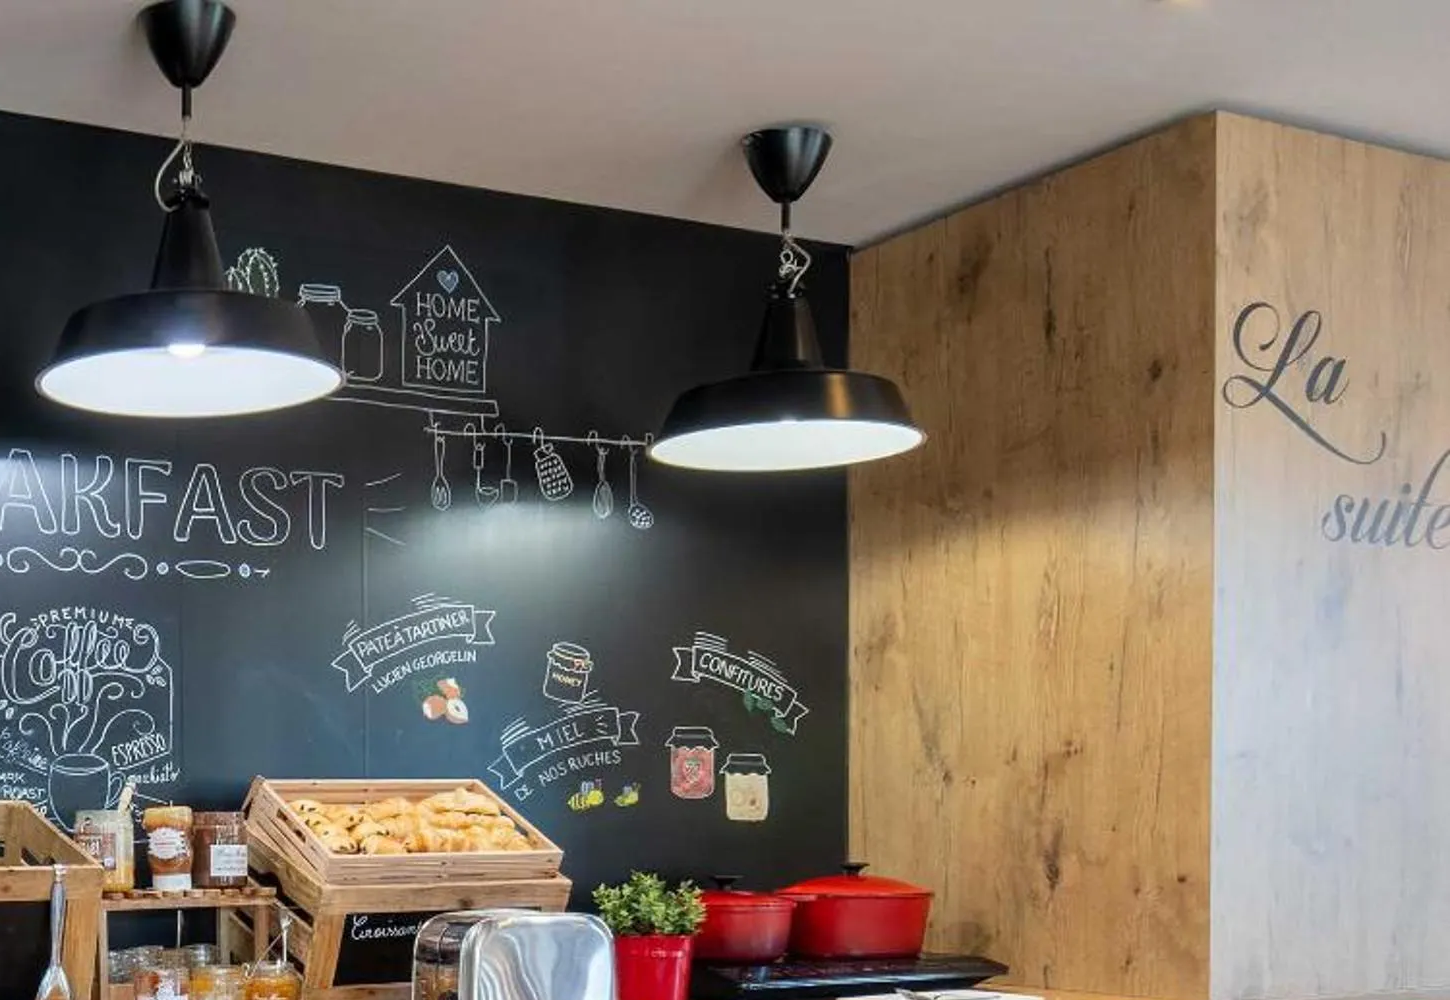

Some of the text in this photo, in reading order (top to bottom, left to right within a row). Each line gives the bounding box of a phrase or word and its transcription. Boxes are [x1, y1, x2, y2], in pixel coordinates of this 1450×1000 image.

[416, 291, 480, 324] HOME
[413, 318, 480, 356] Sweet
[416, 355, 480, 386] HOME
[1222, 301, 1386, 465] La
[700, 653, 784, 701] CONFITURES
[536, 722, 585, 750] MIEL
[568, 750, 621, 771] RUCHES
